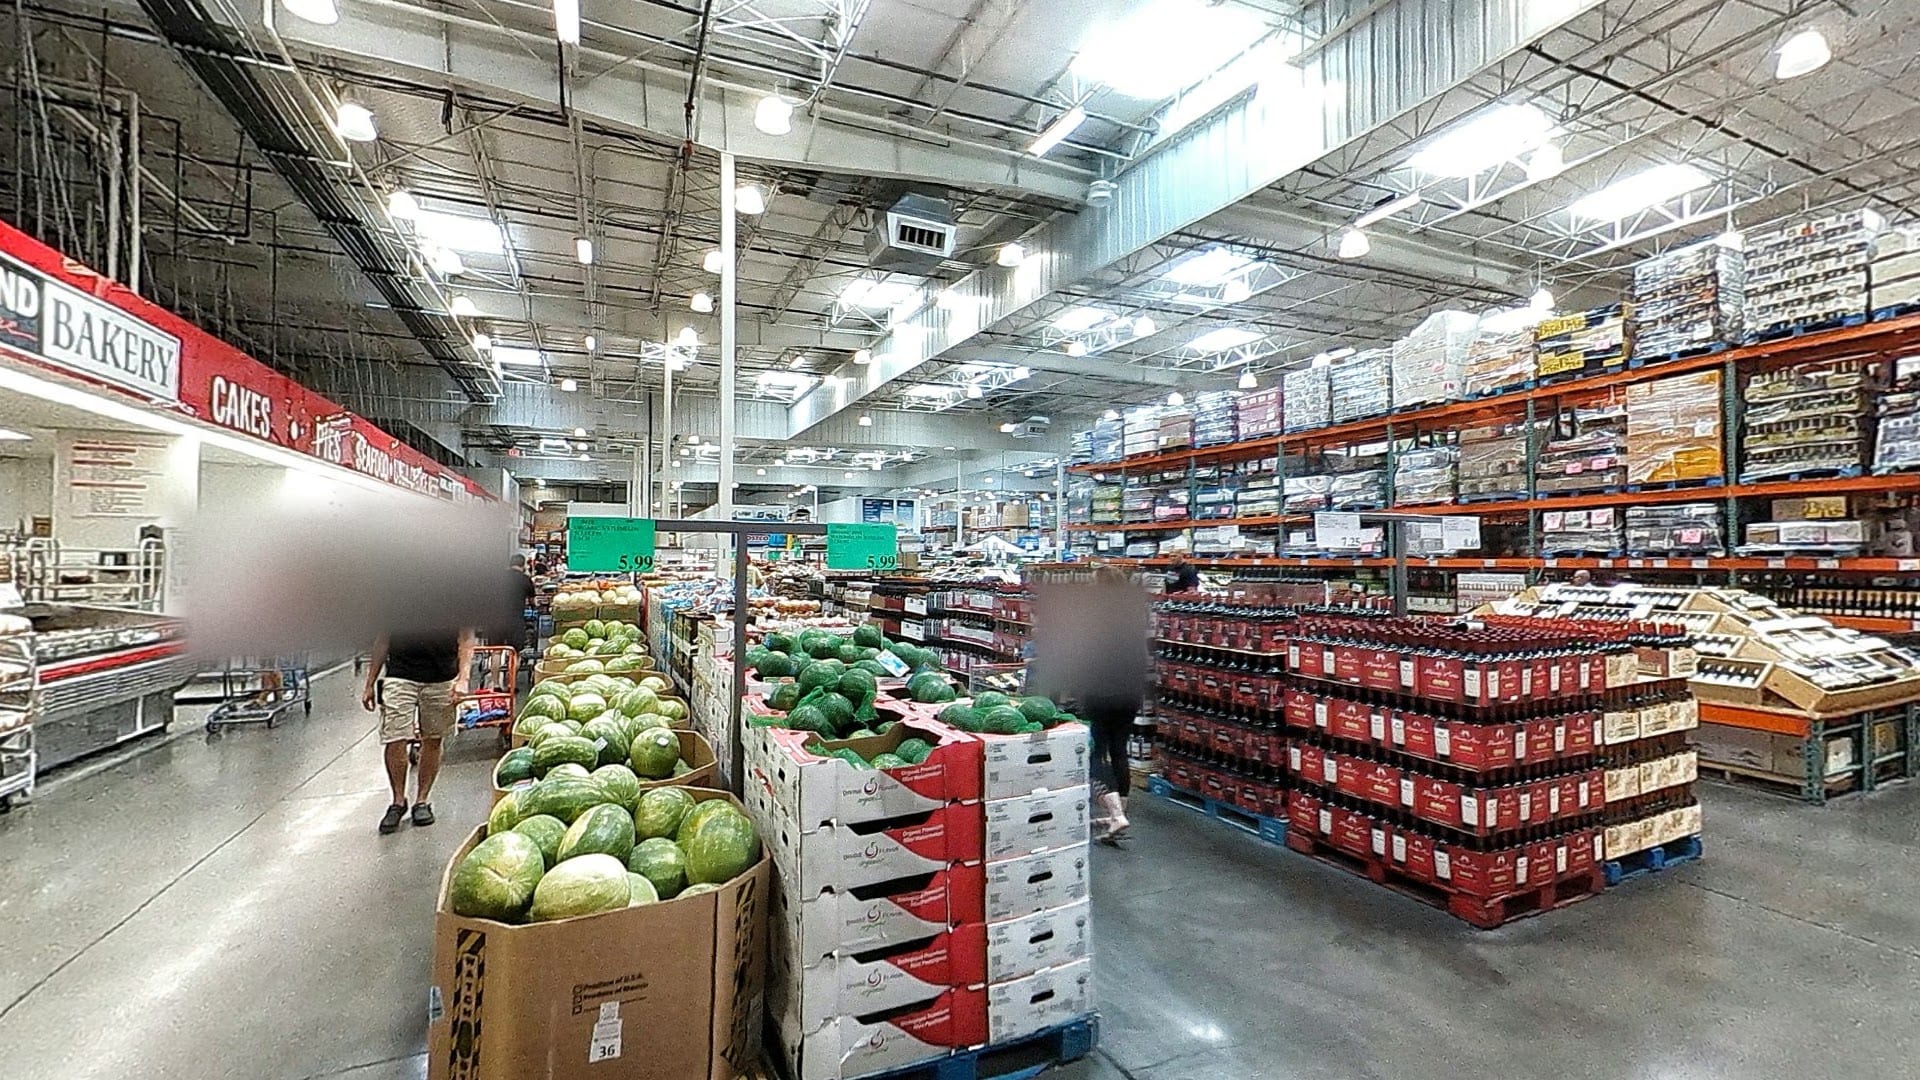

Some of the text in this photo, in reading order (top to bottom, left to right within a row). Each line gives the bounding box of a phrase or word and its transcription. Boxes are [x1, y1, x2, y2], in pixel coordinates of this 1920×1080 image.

[53, 298, 173, 387] BAKERY
[212, 375, 271, 438] CAKES
[355, 432, 389, 481] SEAFOOD
[618, 555, 653, 570] 5.99
[867, 556, 895, 568] 5.99
[599, 1044, 616, 1058] 36
